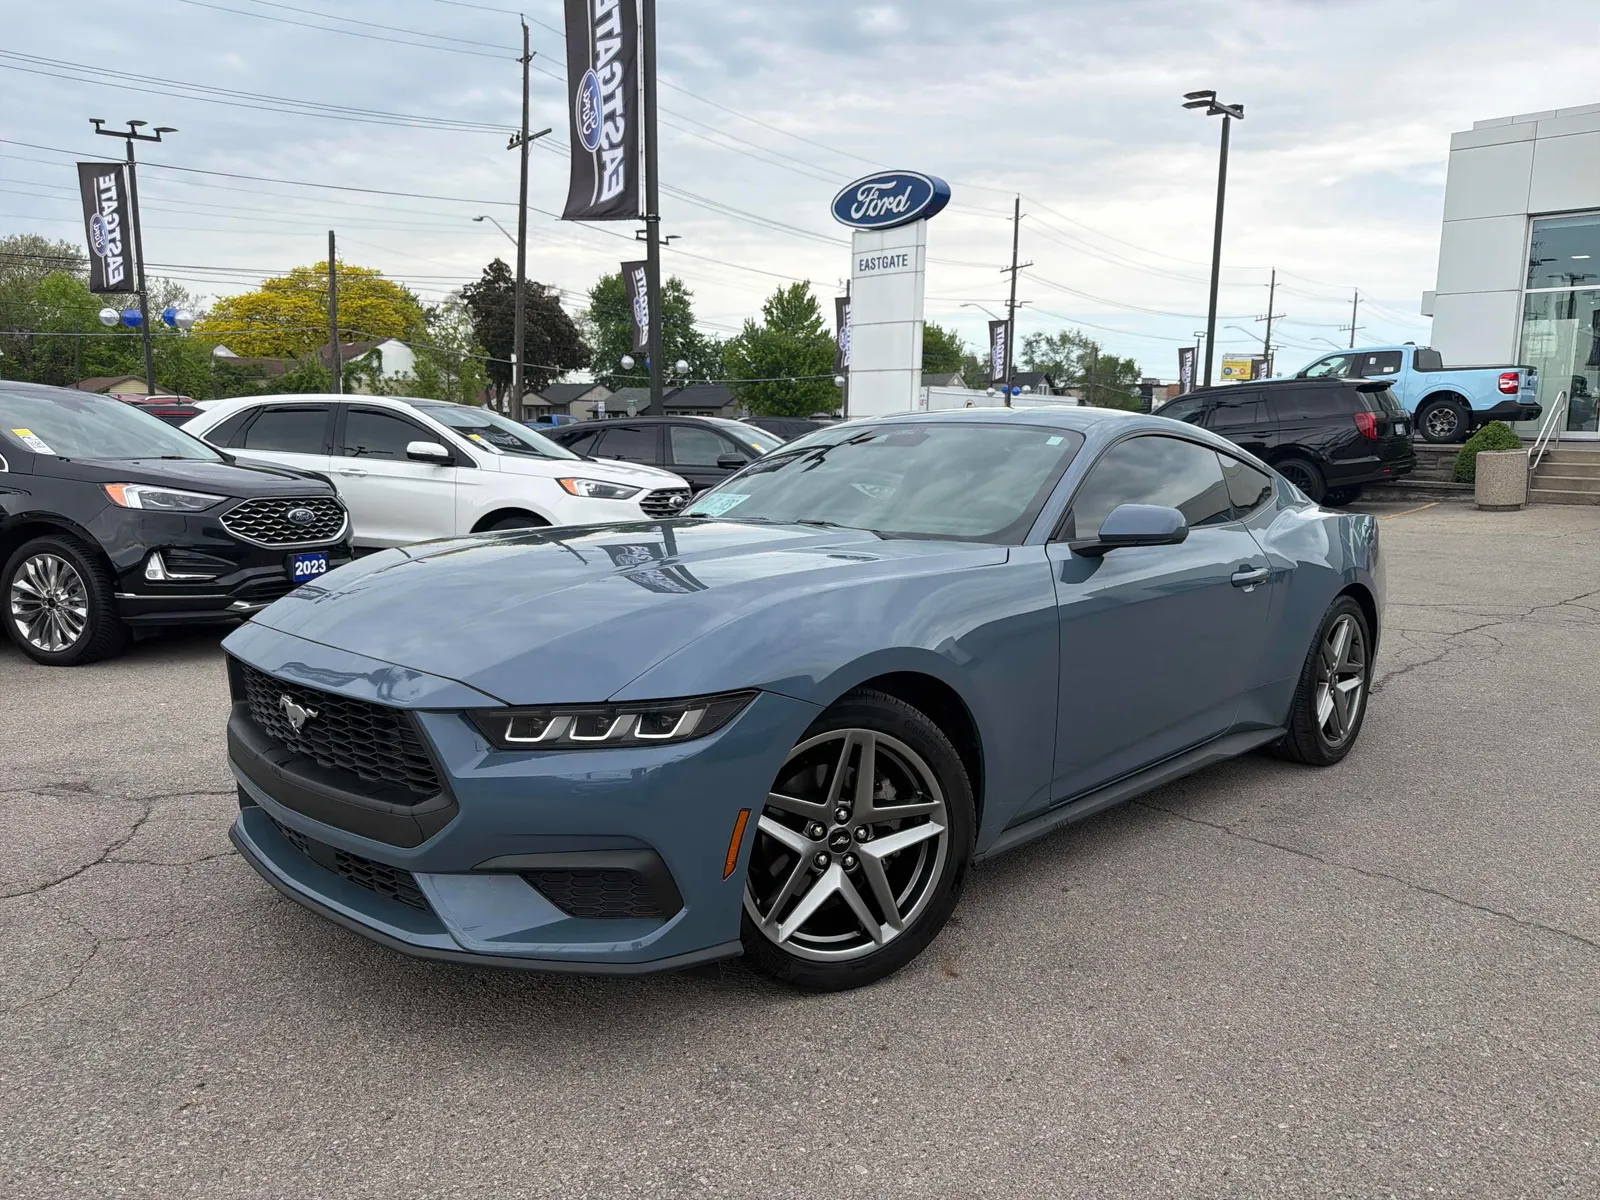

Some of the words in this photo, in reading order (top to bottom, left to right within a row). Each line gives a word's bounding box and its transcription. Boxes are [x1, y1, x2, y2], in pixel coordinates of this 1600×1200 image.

[851, 181, 912, 219] Ford
[859, 254, 908, 272] EASTGATE
[295, 559, 326, 576] 2023
